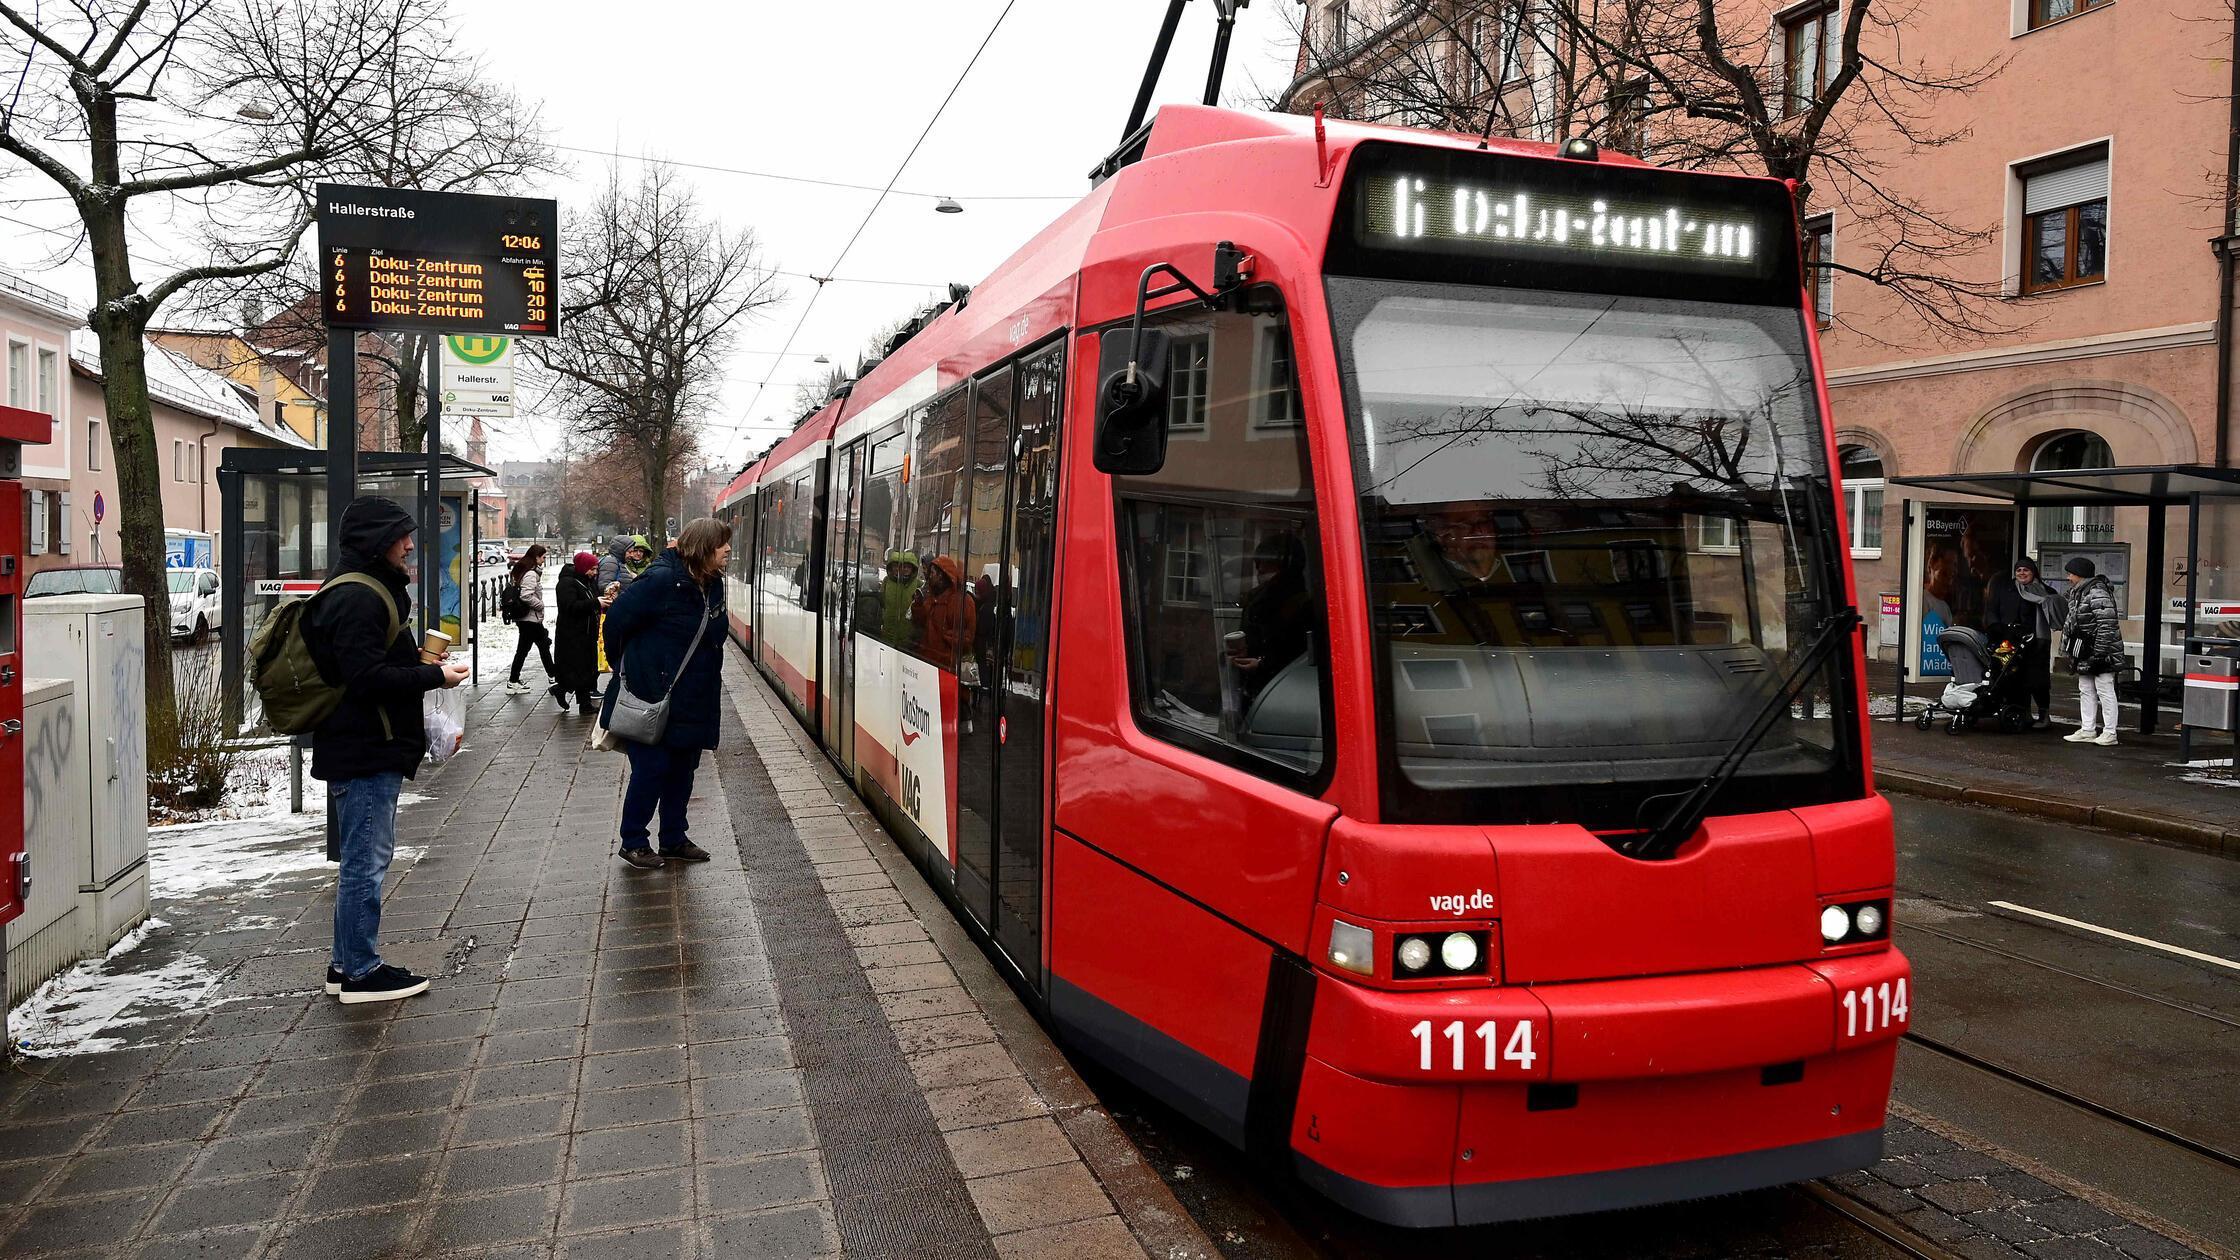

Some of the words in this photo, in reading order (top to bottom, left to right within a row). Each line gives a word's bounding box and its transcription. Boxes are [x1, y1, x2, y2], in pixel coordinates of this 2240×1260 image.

[329, 202, 415, 219] Hallerstraße
[332, 246, 348, 254] Linie
[502, 234, 541, 249] 12:06
[371, 248, 384, 256] Ziel
[334, 254, 345, 267] 6
[369, 256, 482, 275] Doku-Zentrum
[335, 269, 345, 282] 6
[370, 271, 483, 290] Doku-Zentrum
[528, 280, 545, 293] 10
[336, 284, 346, 297] 6
[370, 286, 483, 304] Doku-Zentrum
[527, 294, 545, 307] 20
[336, 299, 346, 312] 6
[371, 301, 484, 319] Doku-Zentrum
[527, 308, 545, 321] 30
[457, 374, 499, 384] Hallerstr.
[2057, 523, 2115, 533] HALLERSTRAßE
[260, 583, 282, 592] VAG
[2204, 606, 2219, 614] VAG
[1923, 623, 1945, 635] Wie
[1923, 658, 1953, 670] Mäde
[901, 683, 930, 737] ÖkoStrom
[902, 764, 921, 823] VAG
[1430, 889, 1494, 915] vag.de
[1843, 978, 1908, 1036] 1114
[1411, 1020, 1537, 1071] 1114
